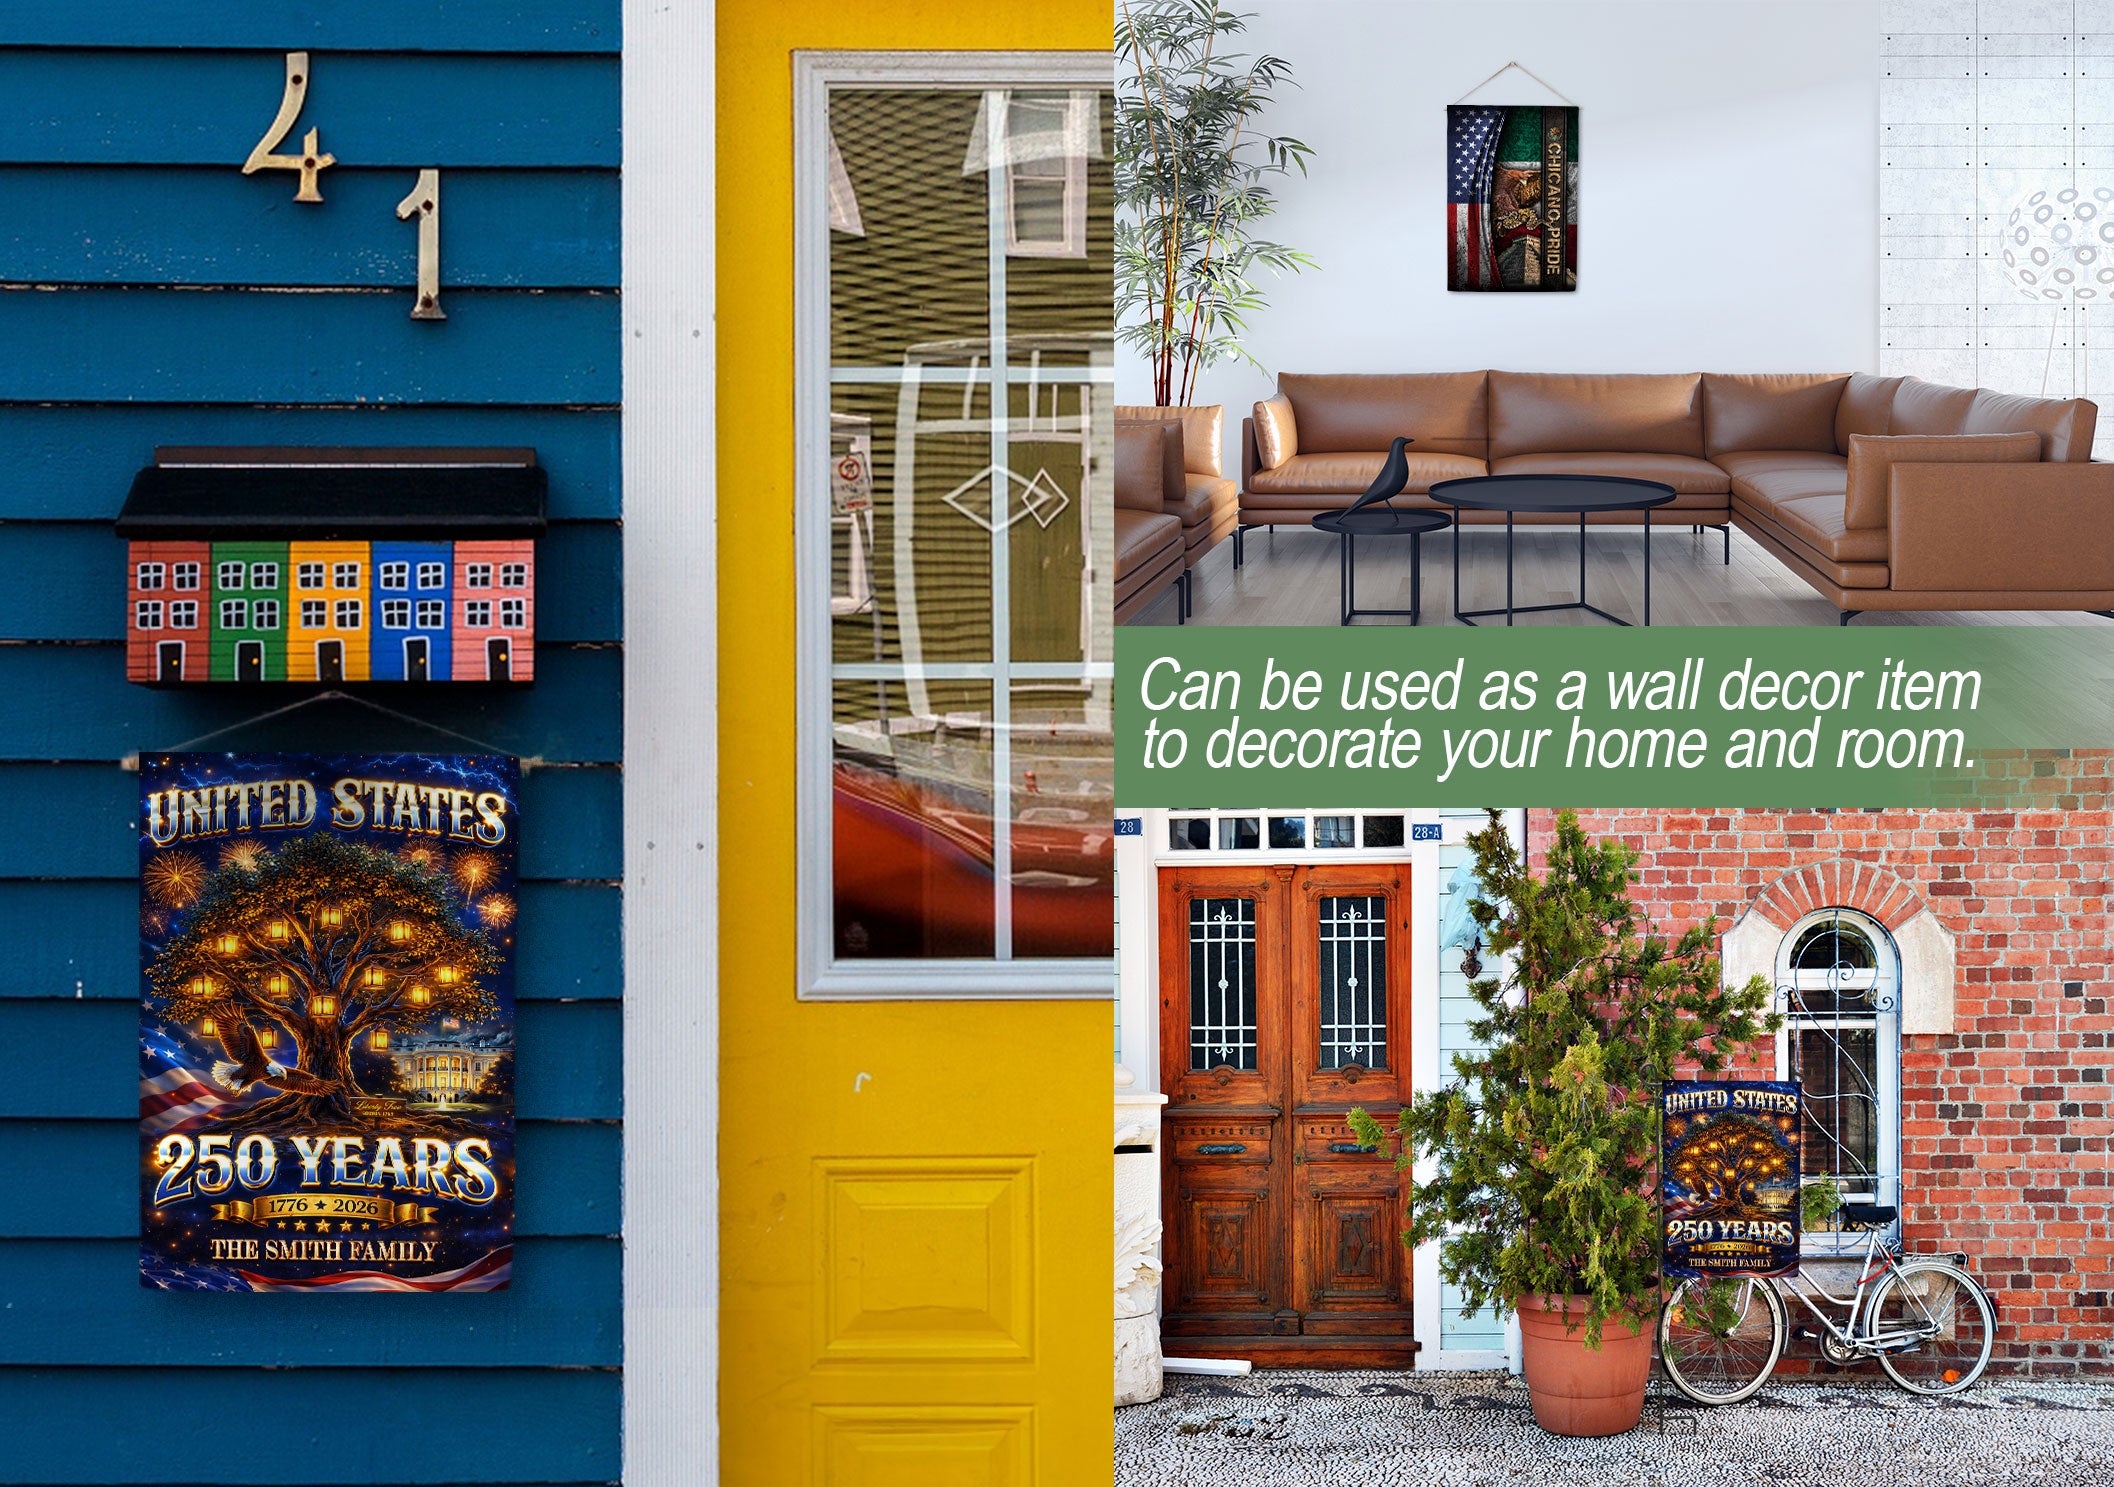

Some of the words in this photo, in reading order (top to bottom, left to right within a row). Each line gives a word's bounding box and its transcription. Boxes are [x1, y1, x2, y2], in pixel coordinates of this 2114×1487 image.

[242, 52, 337, 202] 4
[396, 169, 447, 319] 1
[1547, 144, 1562, 221] CHICANO
[1546, 227, 1562, 276] PRIDE
[149, 779, 317, 848] UNITED
[331, 778, 507, 848] STATES
[1120, 821, 1134, 833] 28
[1414, 826, 1440, 839] 28-A
[1665, 1089, 1728, 1115] UNITED
[1733, 1089, 1798, 1115] STATES
[154, 1133, 279, 1208] 250
[289, 1133, 498, 1206] YEARS
[268, 1198, 308, 1214] 1776
[332, 1198, 379, 1215] 2026
[1668, 1220, 1714, 1247] 250
[1718, 1220, 1796, 1247] YEARS
[210, 1239, 259, 1261] THE
[265, 1239, 343, 1262] SMITH
[348, 1239, 439, 1263] FAMILY
[1688, 1258, 1706, 1267] THE
[1708, 1258, 1737, 1267] SMITH
[1739, 1258, 1772, 1268] FAMILY
